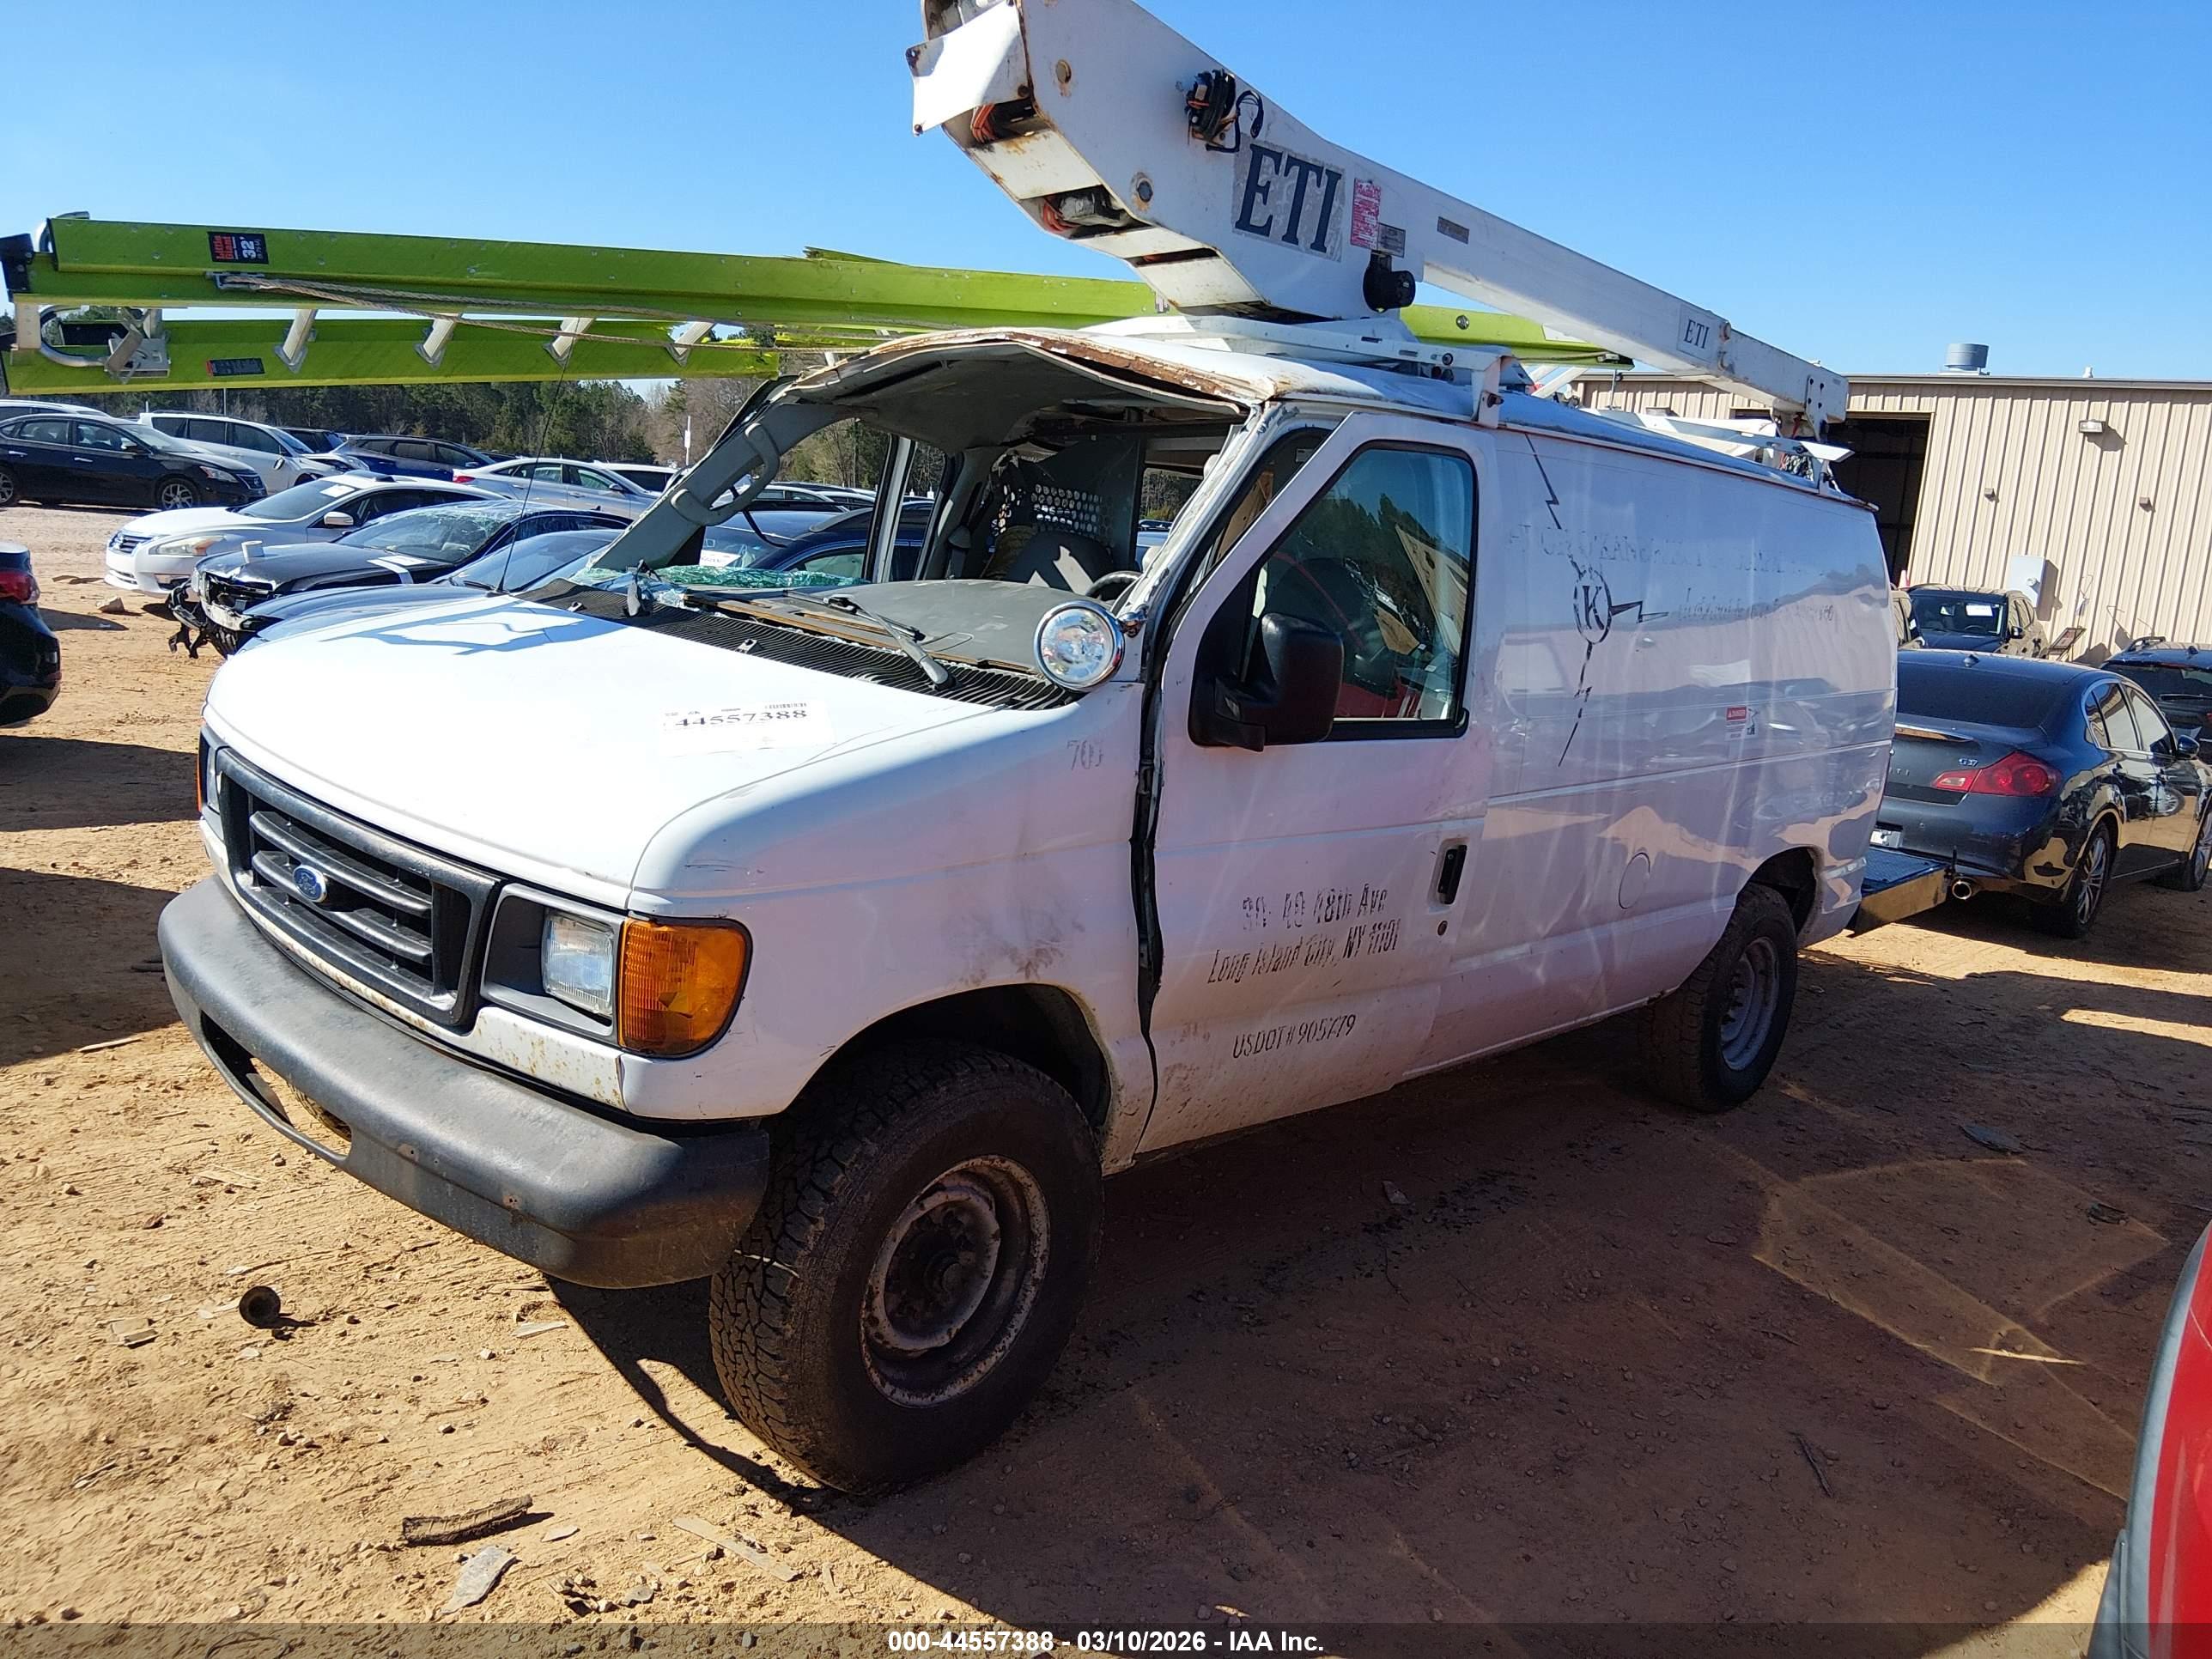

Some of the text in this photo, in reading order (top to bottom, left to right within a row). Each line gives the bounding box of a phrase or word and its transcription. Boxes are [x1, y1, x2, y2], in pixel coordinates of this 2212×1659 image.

[1235, 143, 1342, 253] ETI
[1683, 319, 1710, 349] ETI
[1582, 585, 1605, 630] K
[675, 710, 807, 726] 44557388
[1958, 757, 1979, 768] G37
[1206, 949, 1250, 984] Long
[1251, 936, 1304, 976] Island
[1342, 924, 1367, 959] NY
